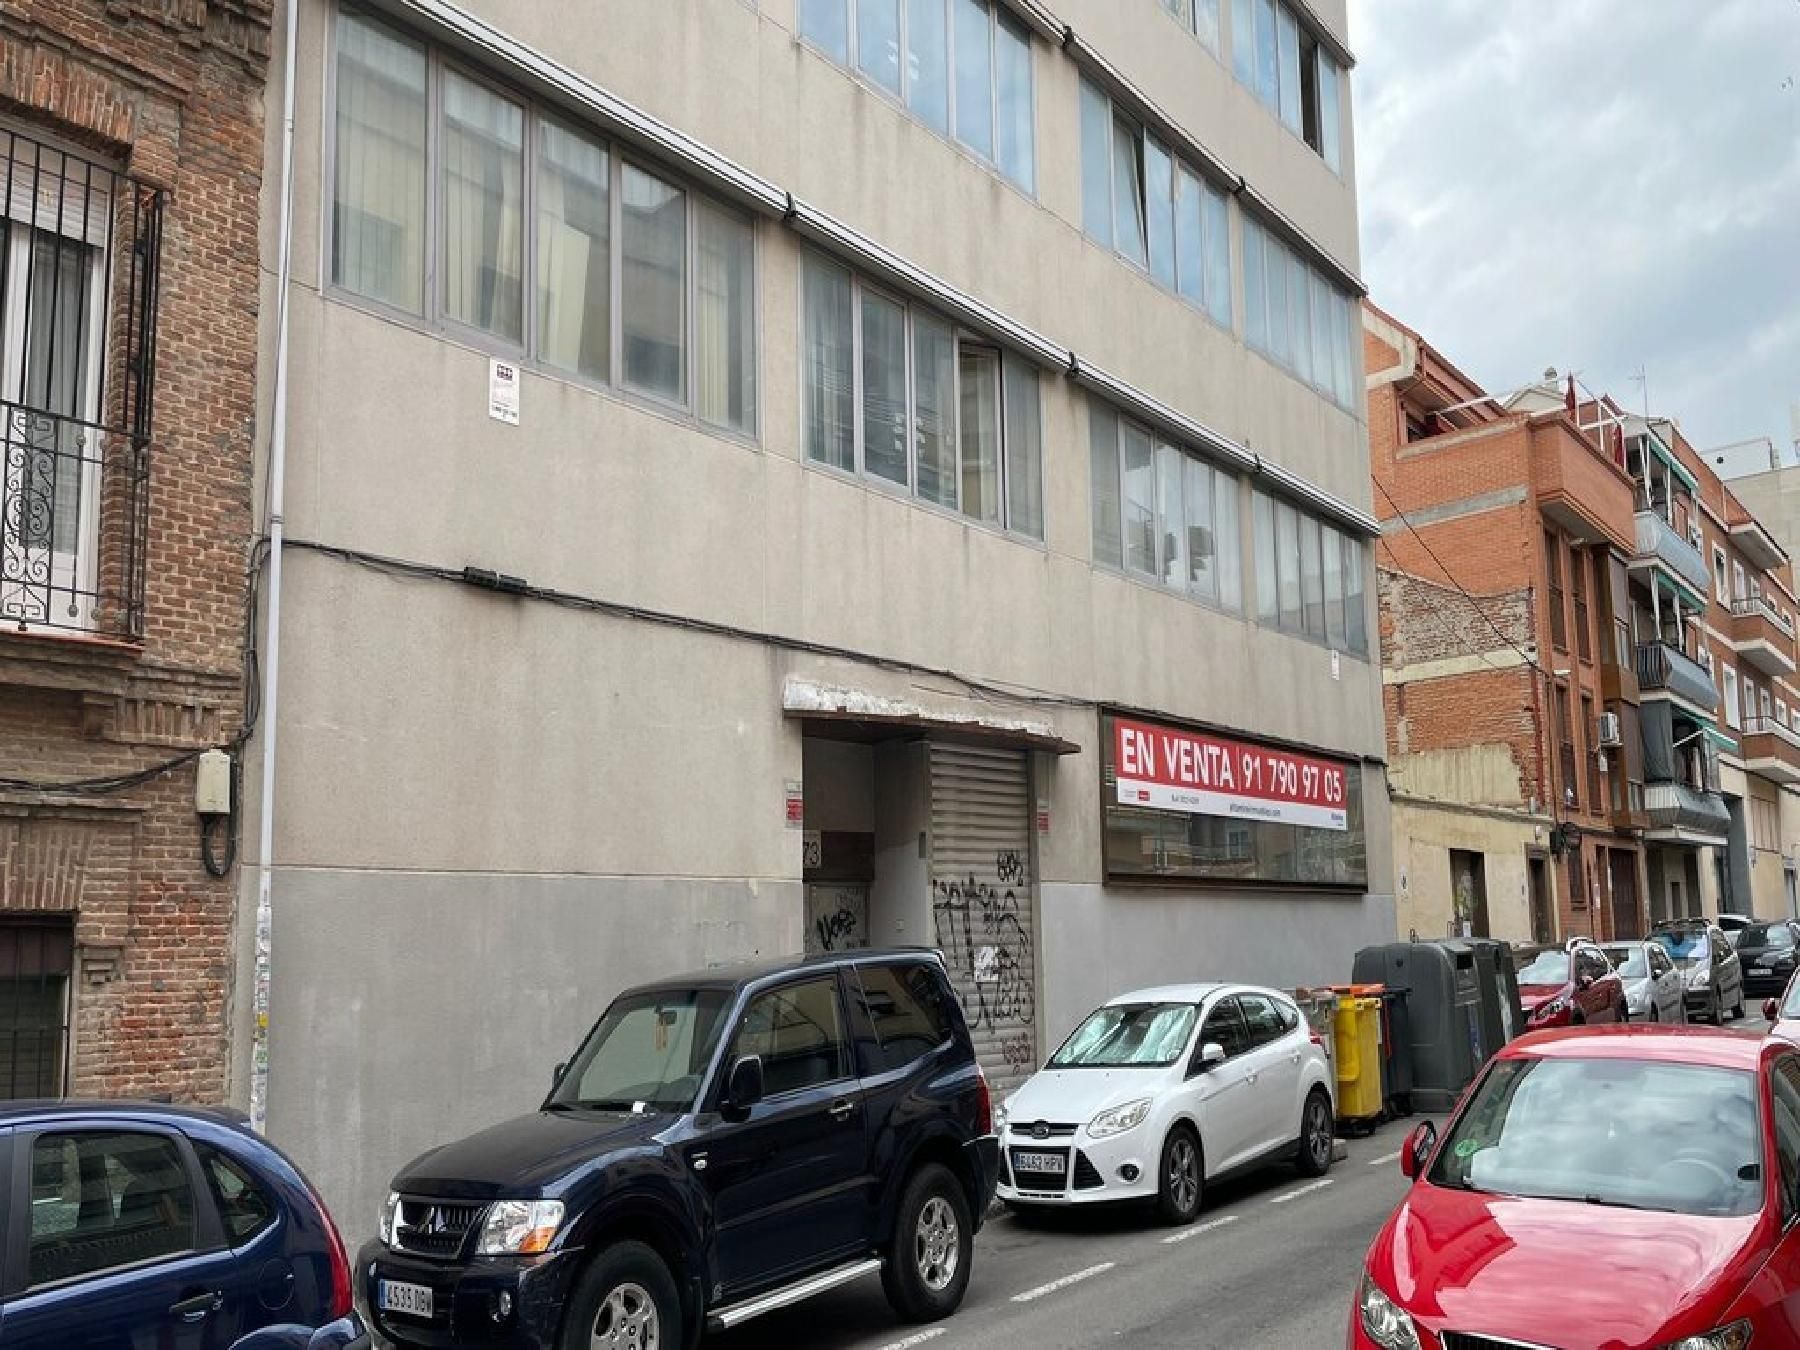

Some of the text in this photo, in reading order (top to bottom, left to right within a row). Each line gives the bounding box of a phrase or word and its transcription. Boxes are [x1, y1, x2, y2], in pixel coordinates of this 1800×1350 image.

[1120, 728, 1342, 802] EN VENTA 91 790 97 05
[387, 1284, 412, 1309] 4535
